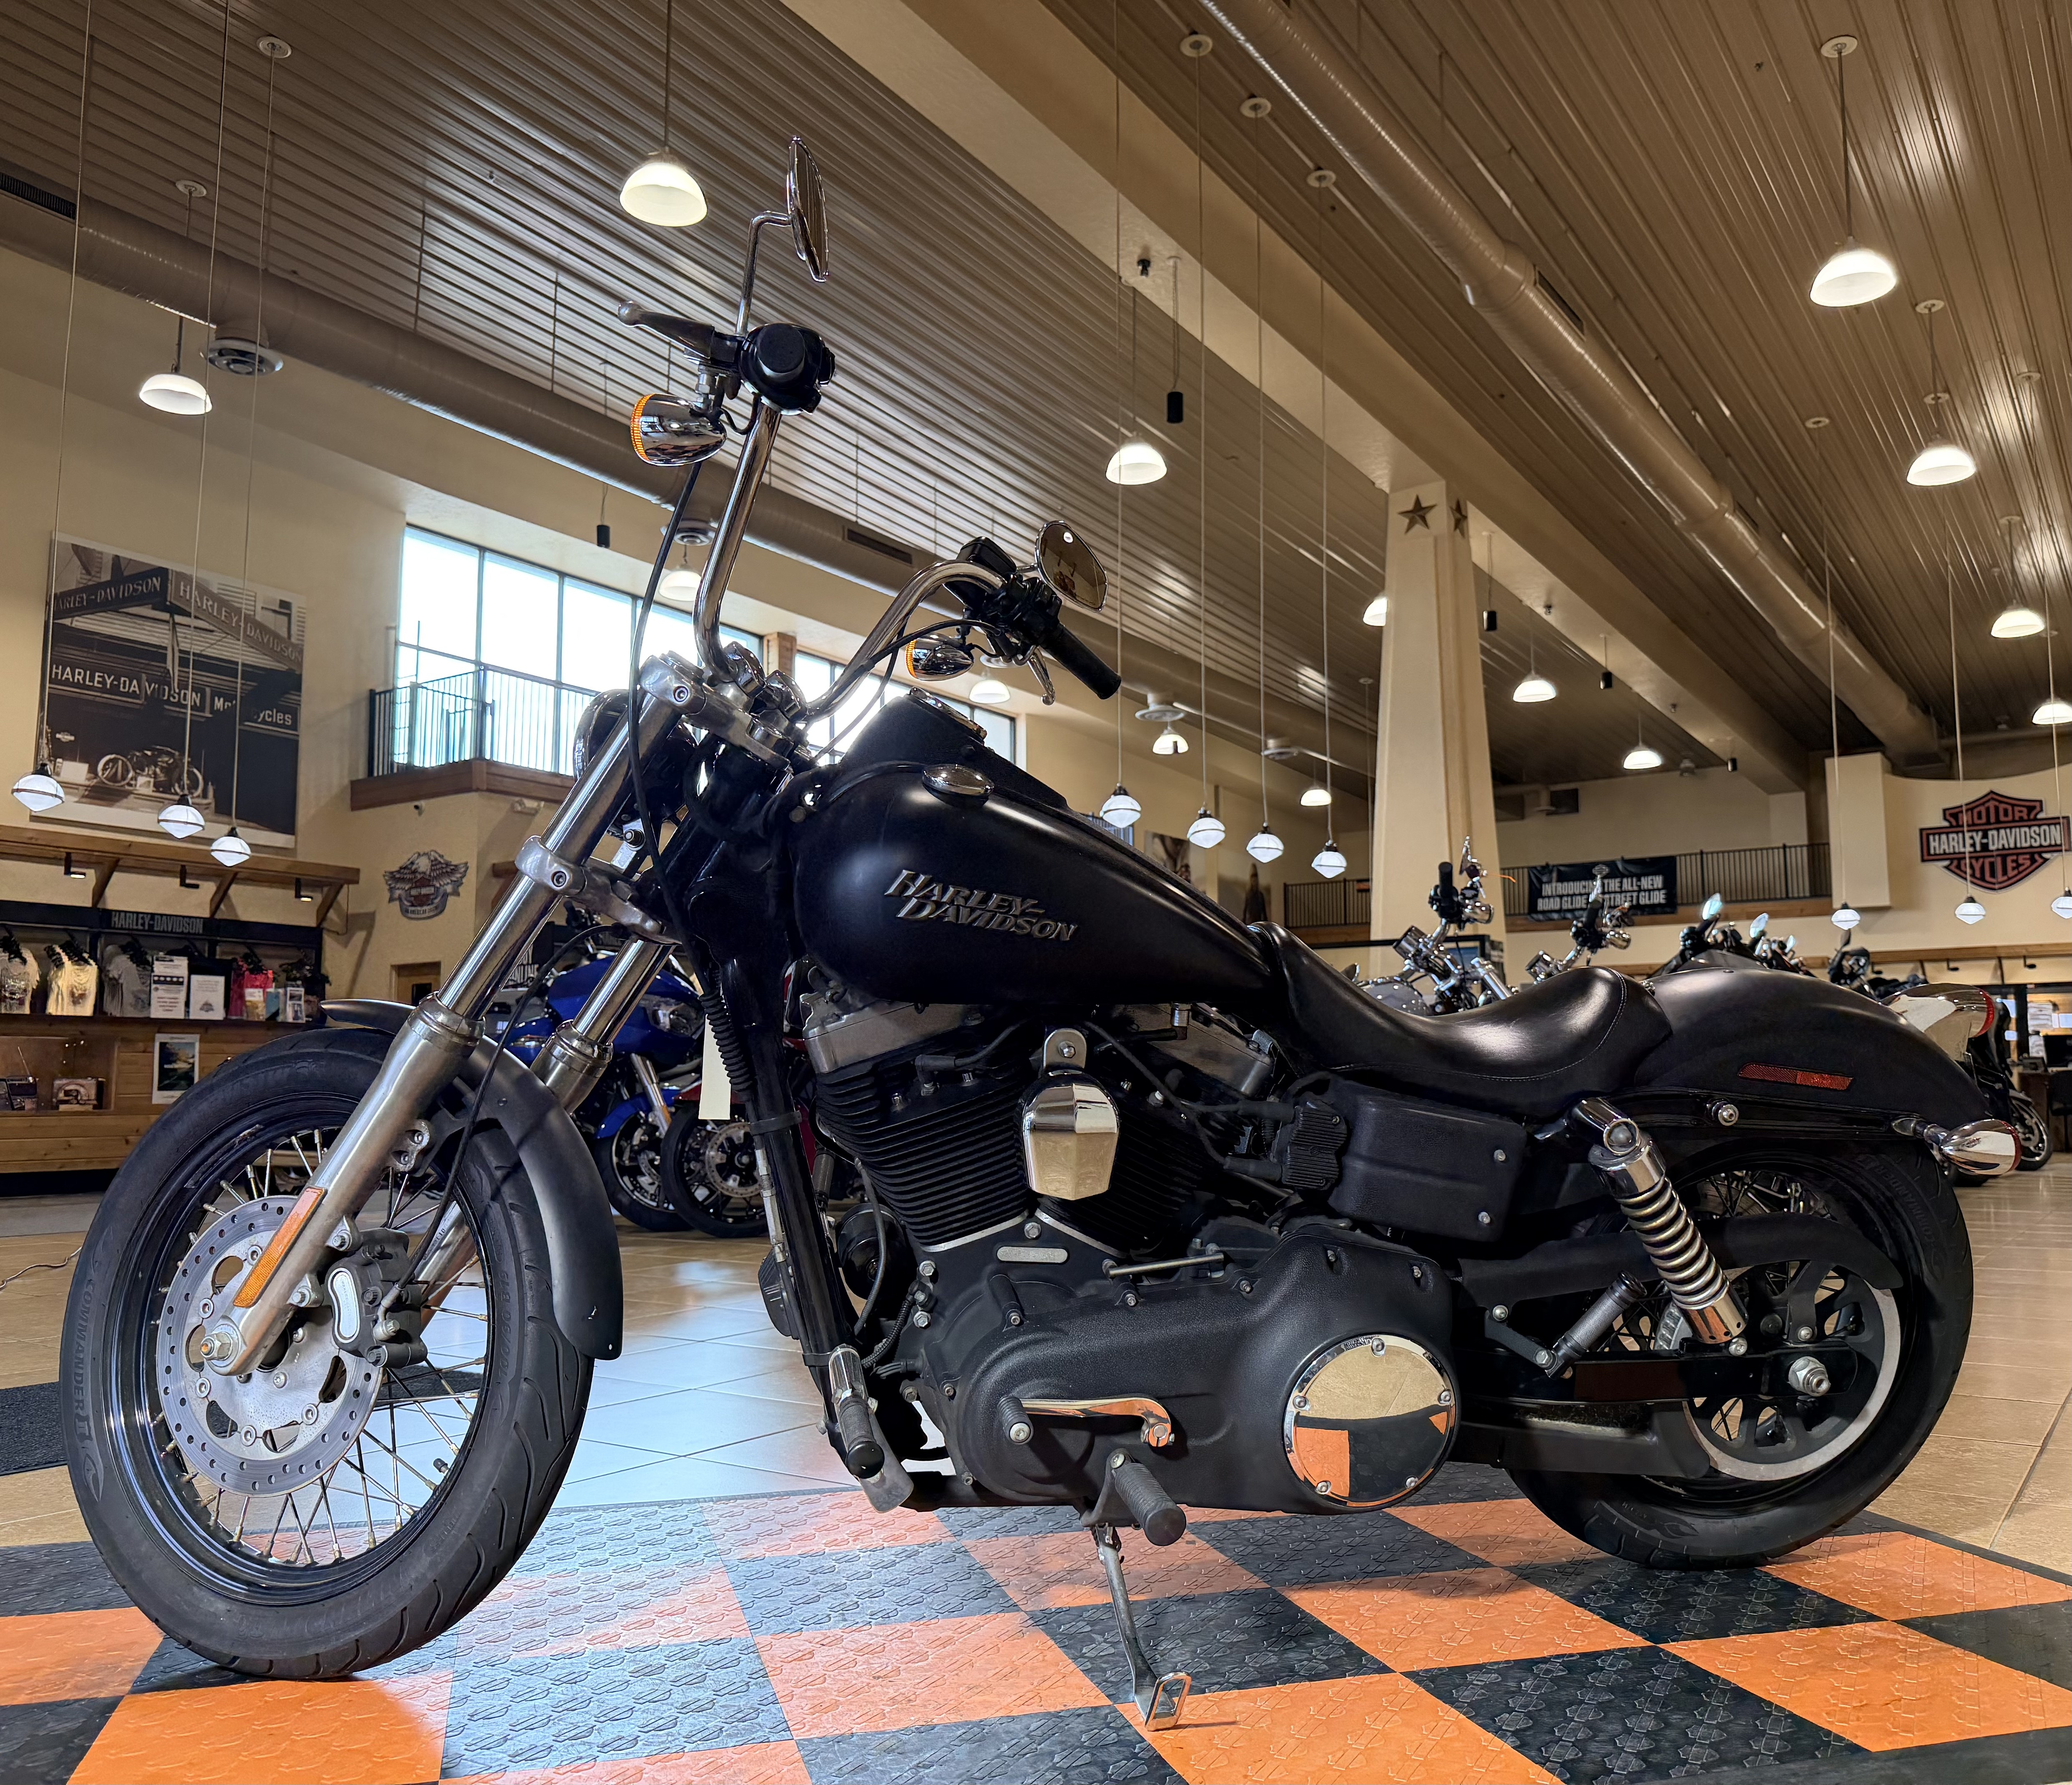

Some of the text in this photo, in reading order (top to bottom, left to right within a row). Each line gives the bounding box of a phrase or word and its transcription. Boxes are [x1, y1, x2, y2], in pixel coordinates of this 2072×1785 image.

[52, 664, 201, 707] HARLEY-DAVIDSON
[1959, 800, 2028, 826] MOTOR
[1928, 824, 2062, 855] HARLEY-DAVIDSON
[1960, 854, 2032, 882] CYCLES
[884, 869, 1045, 916] HARLEY-
[1537, 896, 1560, 911] ROAD
[1562, 895, 1588, 909] GLIDE
[1639, 889, 1667, 905] GLIDE
[1542, 875, 1663, 896] INTRODUCIN THE ALL-NEW
[112, 911, 204, 934] HARLEY-DAVIDSON
[896, 897, 1078, 941] DAVIDSON
[73, 1280, 94, 1412] COMMANDER
